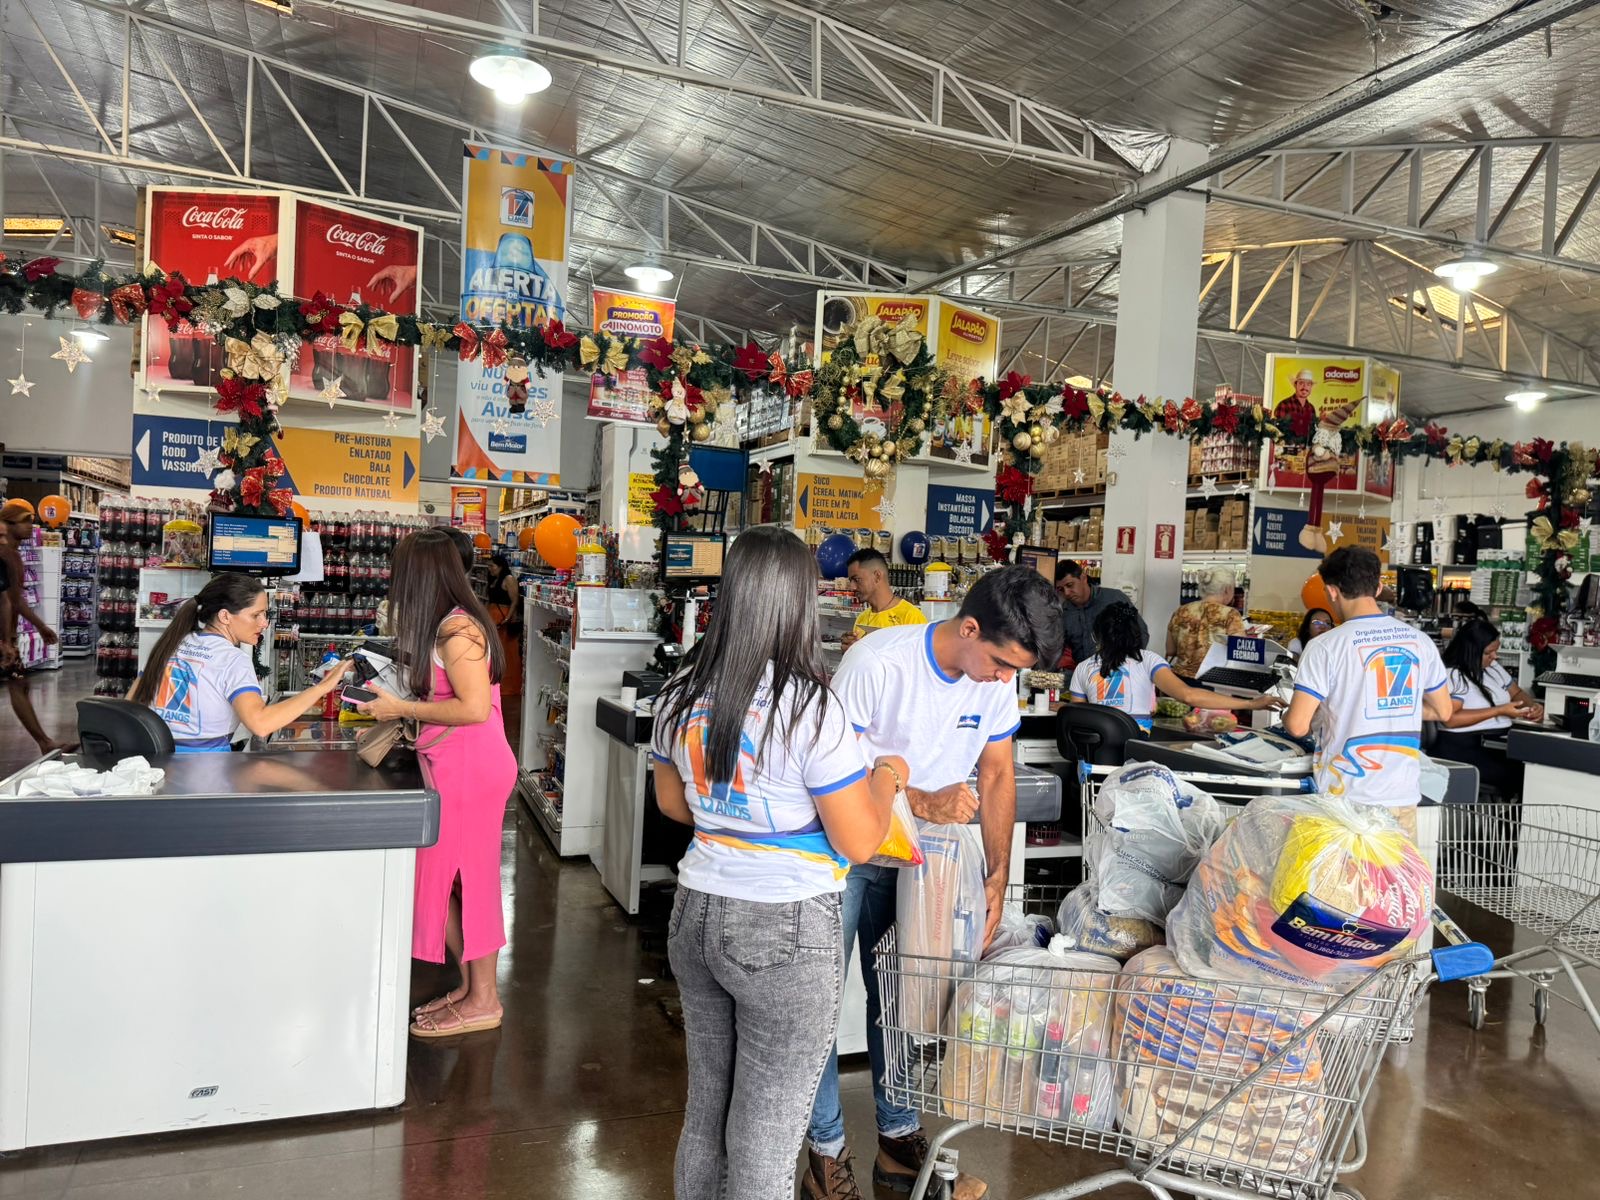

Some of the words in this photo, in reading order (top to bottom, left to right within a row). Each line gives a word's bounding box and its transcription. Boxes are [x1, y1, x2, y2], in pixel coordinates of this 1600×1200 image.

[182, 205, 245, 230] Coca-Cola
[326, 223, 388, 255] Coca-Cola
[336, 250, 352, 259] SINTA
[356, 254, 375, 264] SABOR
[469, 267, 556, 302] ALERTA
[612, 310, 655, 321] PROMOÇÃO
[602, 321, 662, 334] AJINOMOTO
[952, 315, 985, 337] JALAPÃO
[162, 431, 204, 446] PRODUTO
[206, 435, 219, 447] DE
[162, 445, 187, 458] RODO
[349, 446, 391, 461] ENLATADO
[369, 461, 391, 474] BALA
[343, 472, 391, 487] CHOCOLATE
[813, 475, 830, 486] SUCO
[314, 483, 352, 497] PRODUTO
[354, 486, 392, 499] NATURAL
[813, 486, 836, 497] CEREAL
[812, 497, 829, 508] LEITE
[831, 499, 840, 508] EM
[955, 493, 976, 504] MASSA
[812, 508, 834, 519] BEBIDA
[937, 502, 976, 514] INSTANTÂNEO
[949, 513, 975, 525] BOLACHA
[1266, 512, 1283, 522] MOLHO
[948, 523, 974, 535] BISCOITO
[1266, 522, 1282, 532] AZEITE
[1265, 531, 1287, 542] BISCOITO
[1265, 541, 1285, 551] VINAGRE
[1355, 629, 1382, 637] Orgulho
[1236, 638, 1257, 652] CAIXA
[1353, 638, 1371, 646] parte
[1232, 649, 1260, 662] FECHADO
[1369, 654, 1413, 698] 17
[1390, 696, 1414, 707] ANOS
[164, 710, 191, 724] ANOS
[715, 803, 753, 822] ANOS
[1288, 916, 1332, 941] Bem
[1328, 933, 1386, 951] Maior
[191, 1087, 218, 1098] FAST
